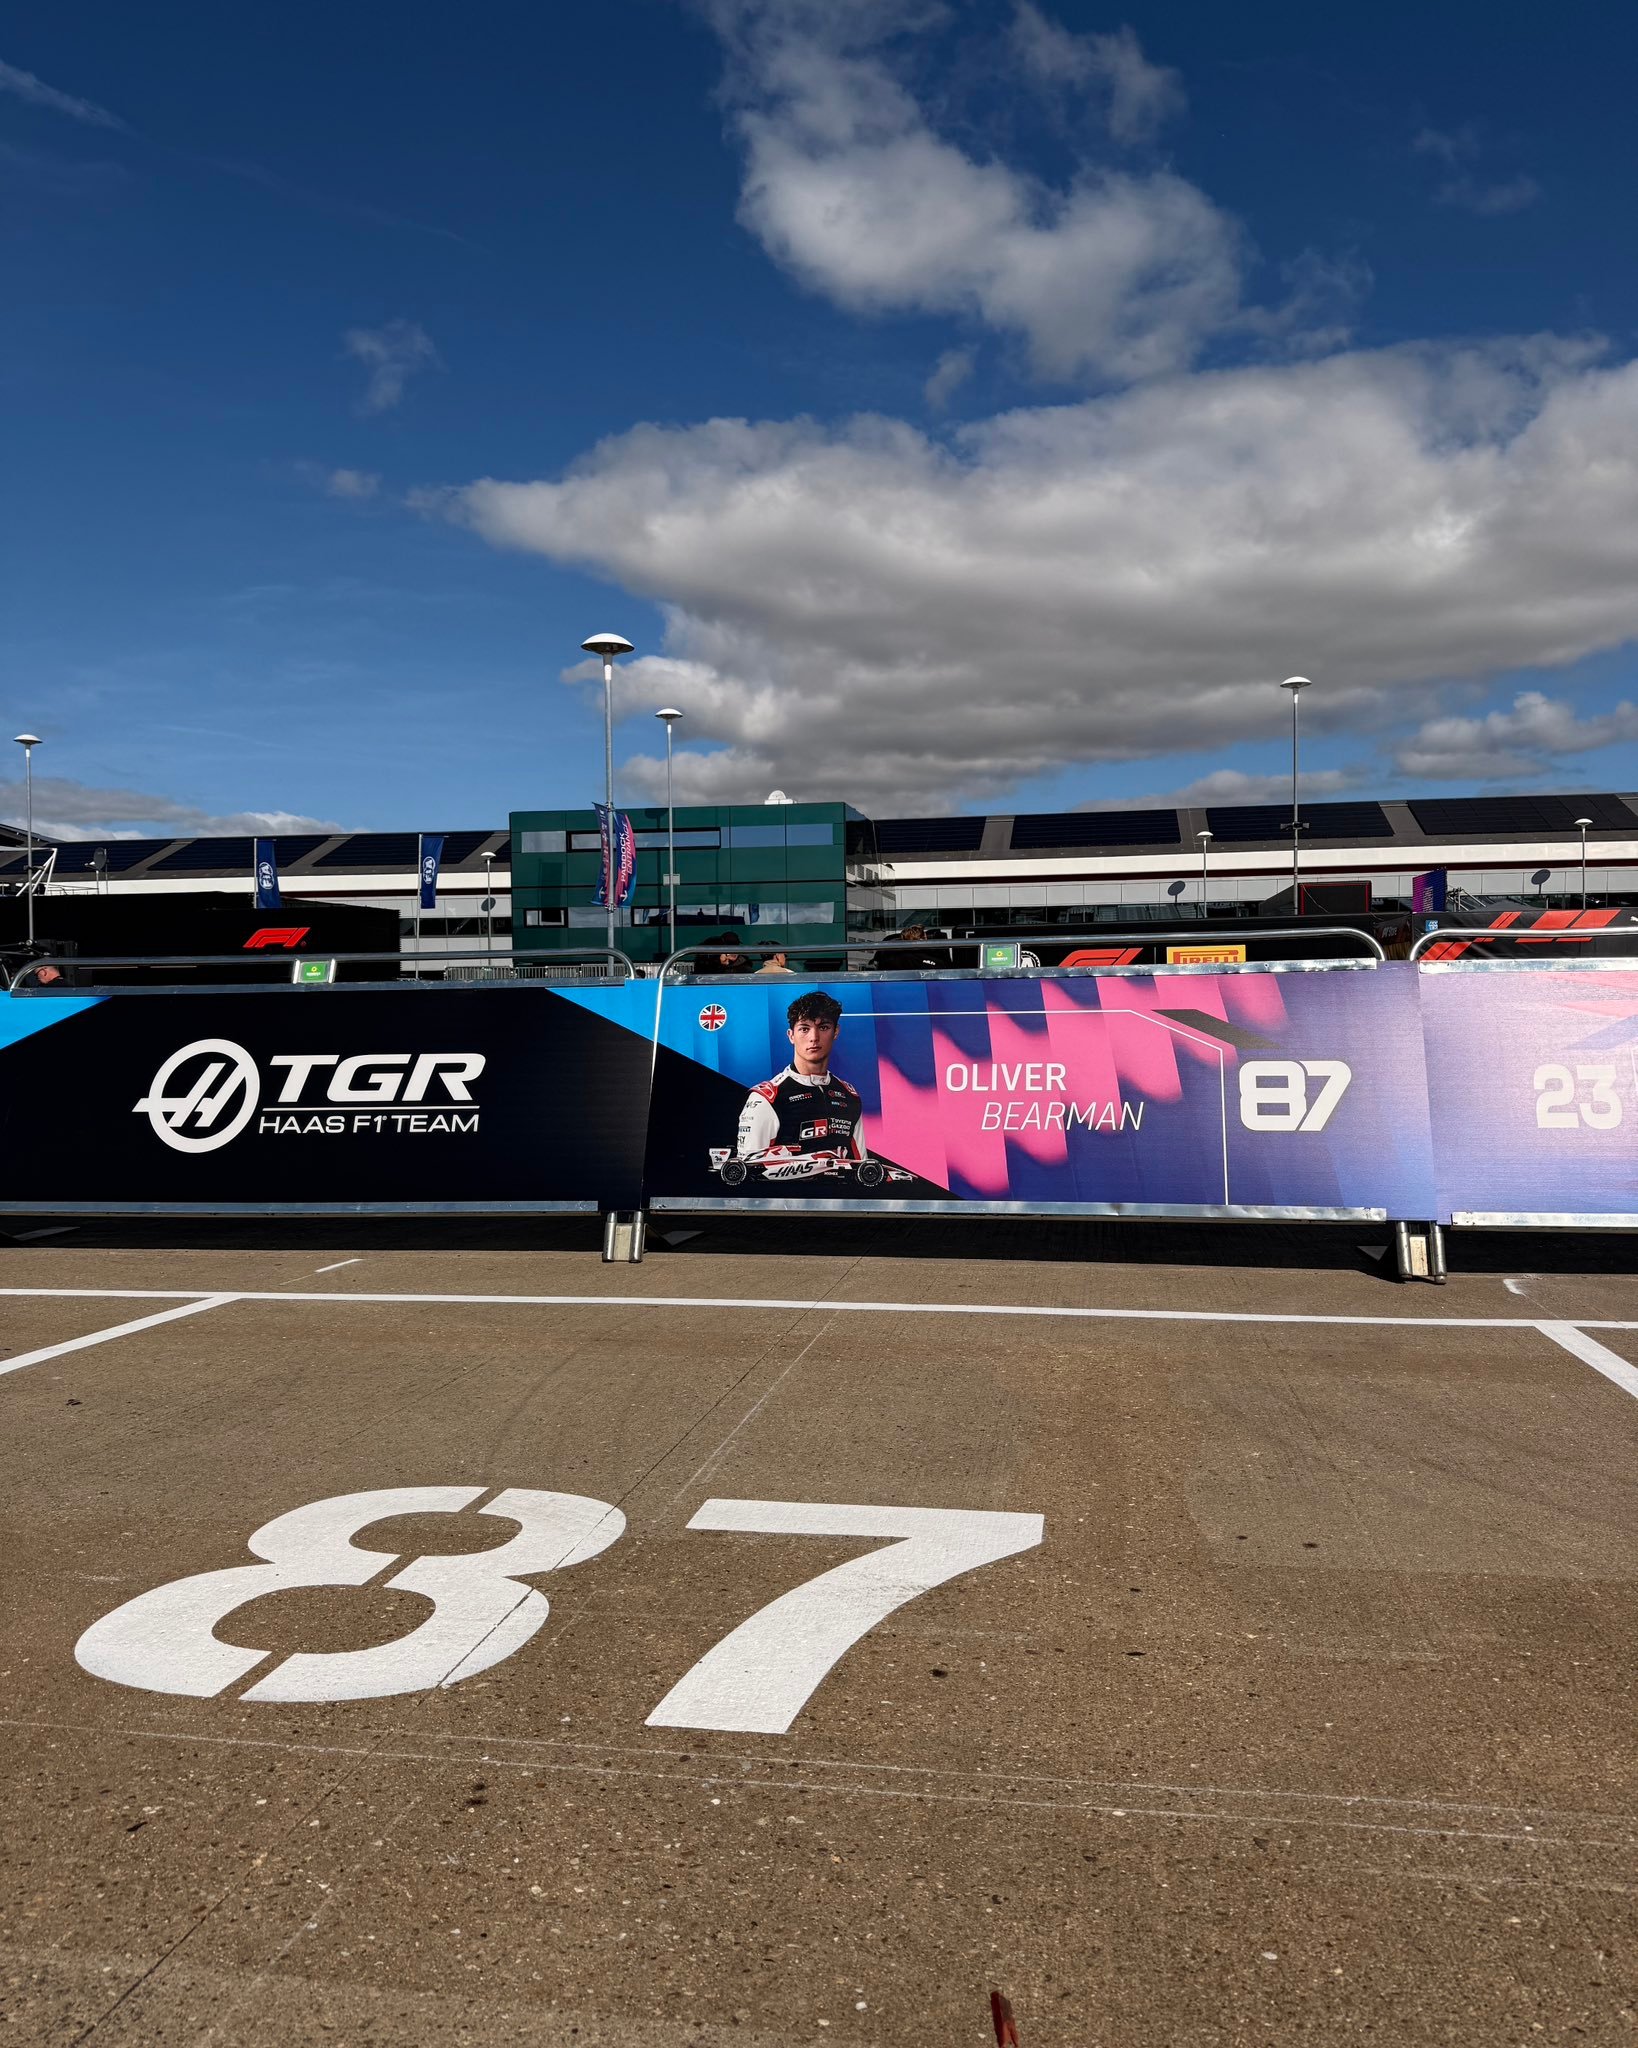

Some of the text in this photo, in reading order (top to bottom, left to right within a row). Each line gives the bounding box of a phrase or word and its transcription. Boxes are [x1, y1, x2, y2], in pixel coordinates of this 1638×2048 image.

[619, 832, 628, 882] PADDOCK
[269, 1053, 487, 1102] TGR
[945, 1062, 1067, 1092] OLIVER
[1238, 1060, 1352, 1132] 87
[1533, 1063, 1624, 1130] 23
[258, 1115, 346, 1134] HAAS
[395, 1114, 480, 1133] TEAM
[980, 1101, 1145, 1132] BEARMAN
[74, 1485, 1045, 1735] 87
